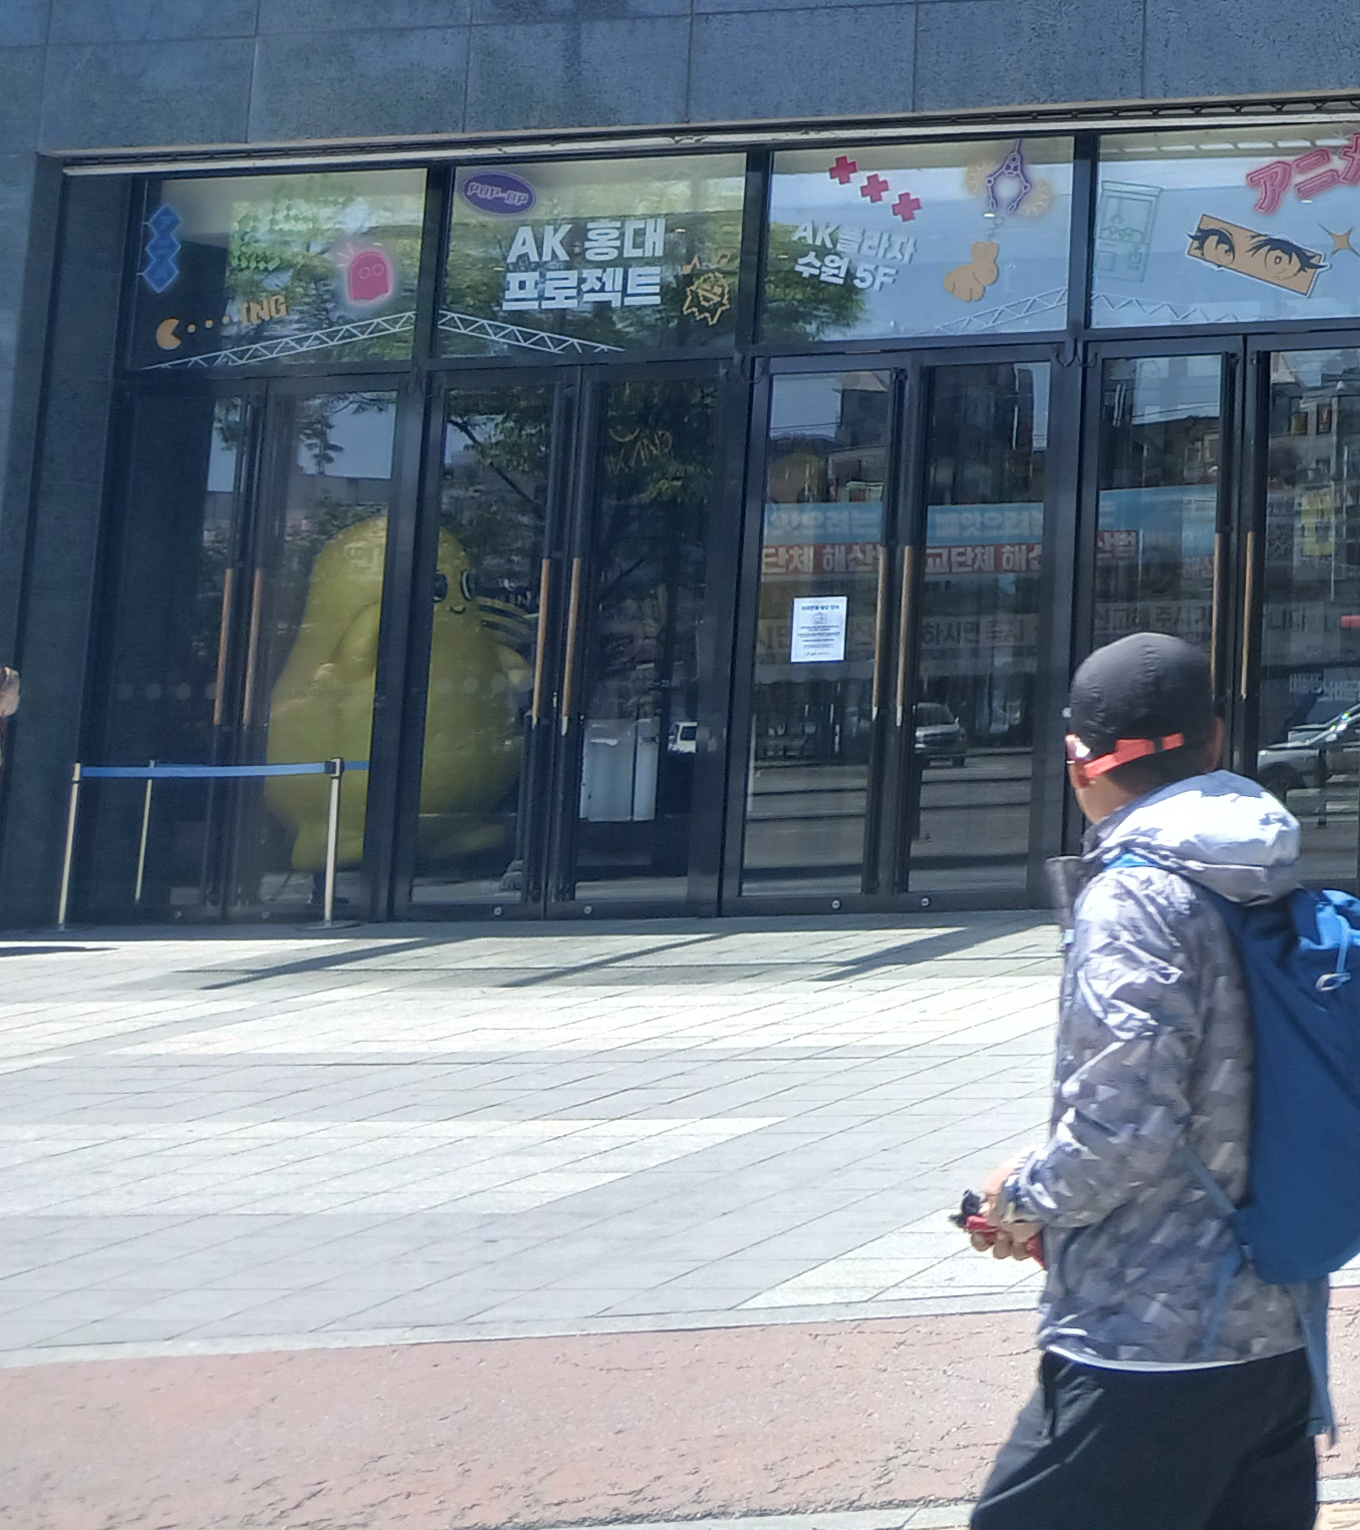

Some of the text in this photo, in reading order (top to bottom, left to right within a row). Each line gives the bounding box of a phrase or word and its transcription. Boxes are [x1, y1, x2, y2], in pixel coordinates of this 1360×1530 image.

[466, 182, 528, 207] POP-UP
[506, 218, 666, 264] AK 홍대
[502, 267, 662, 311] 프로젝트
[794, 251, 899, 291] 수원 5F
